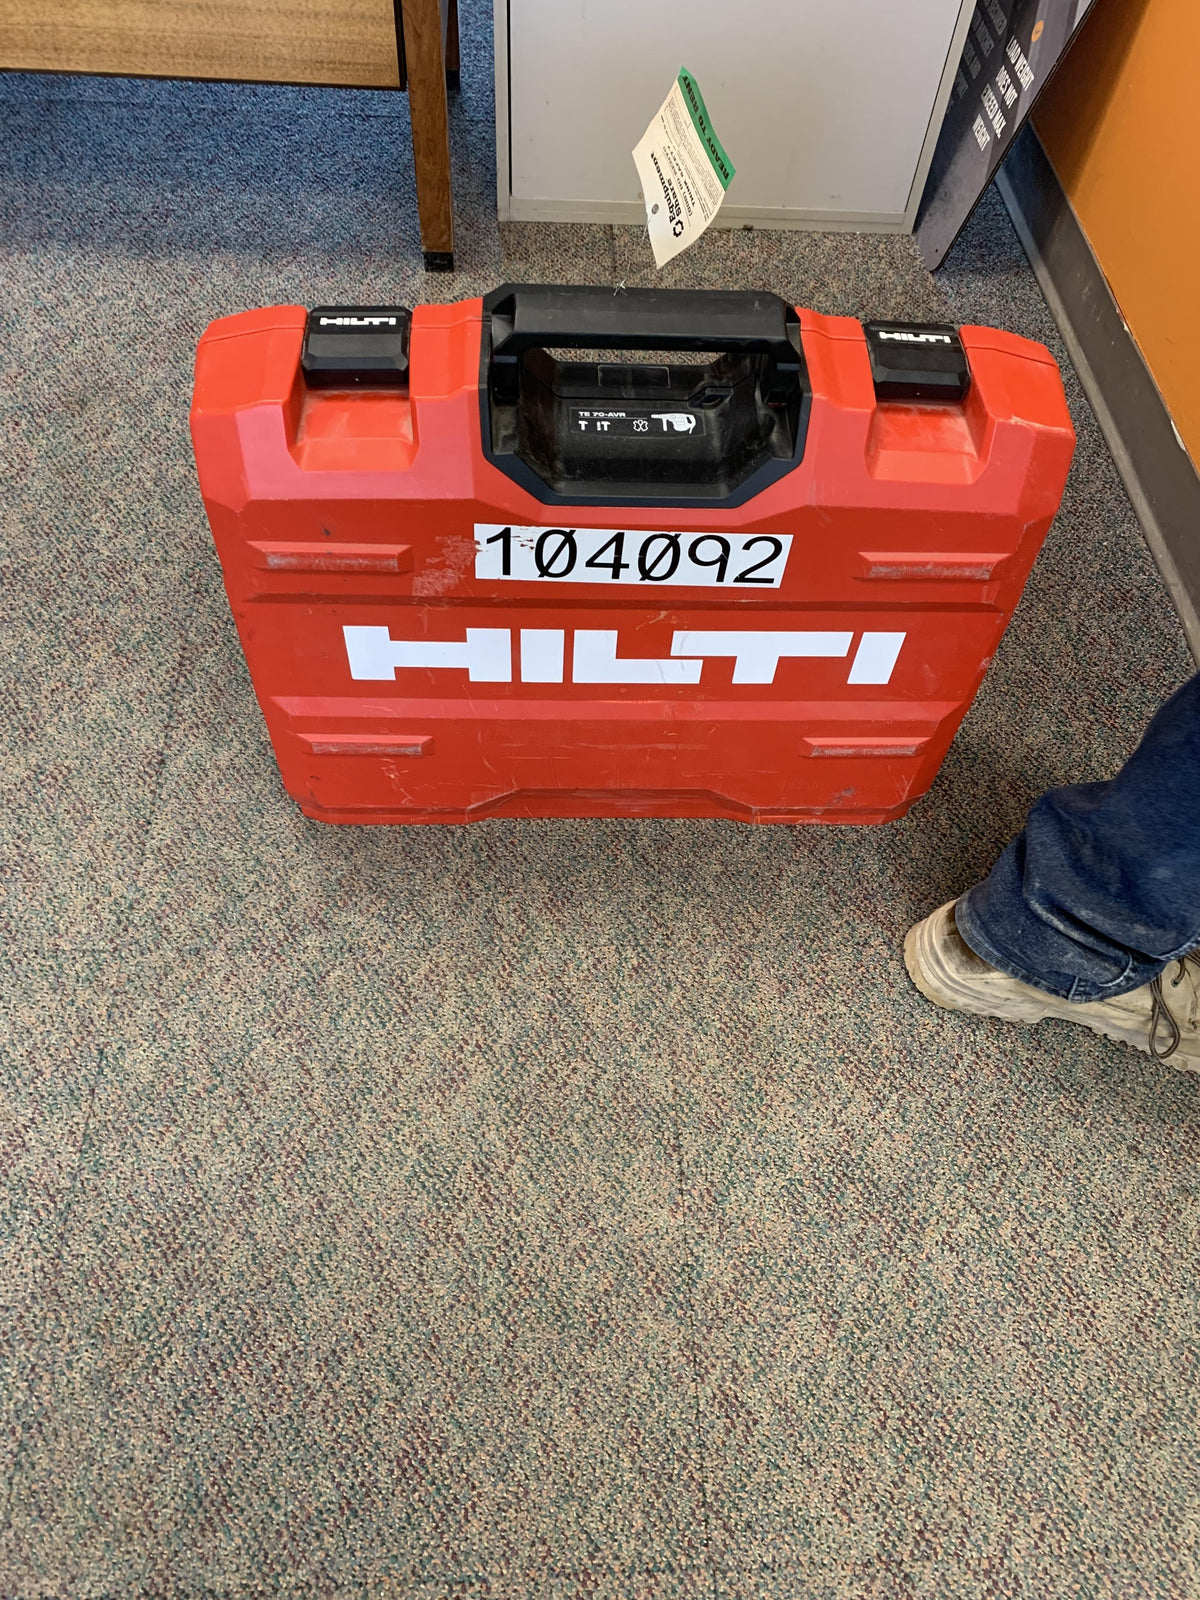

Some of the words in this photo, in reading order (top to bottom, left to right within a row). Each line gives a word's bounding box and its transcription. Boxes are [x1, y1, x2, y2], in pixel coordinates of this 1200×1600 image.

[1006, 35, 1021, 64] LOAD
[1014, 53, 1035, 91] WEIGHT
[682, 75, 699, 114] RENT
[981, 83, 999, 120] EXCEED
[995, 64, 1011, 95] DOES
[1003, 83, 1018, 109] NOT
[698, 115, 707, 136] TO
[972, 113, 991, 151] WEIGHT
[667, 146, 684, 177] SAFETY
[707, 137, 730, 181] READY
[650, 150, 676, 224] Equipment
[667, 178, 682, 218] Share
[684, 179, 696, 207] THINK
[320, 317, 396, 325] HILTI
[879, 331, 951, 343] HILTI
[342, 625, 907, 685] HILTI
